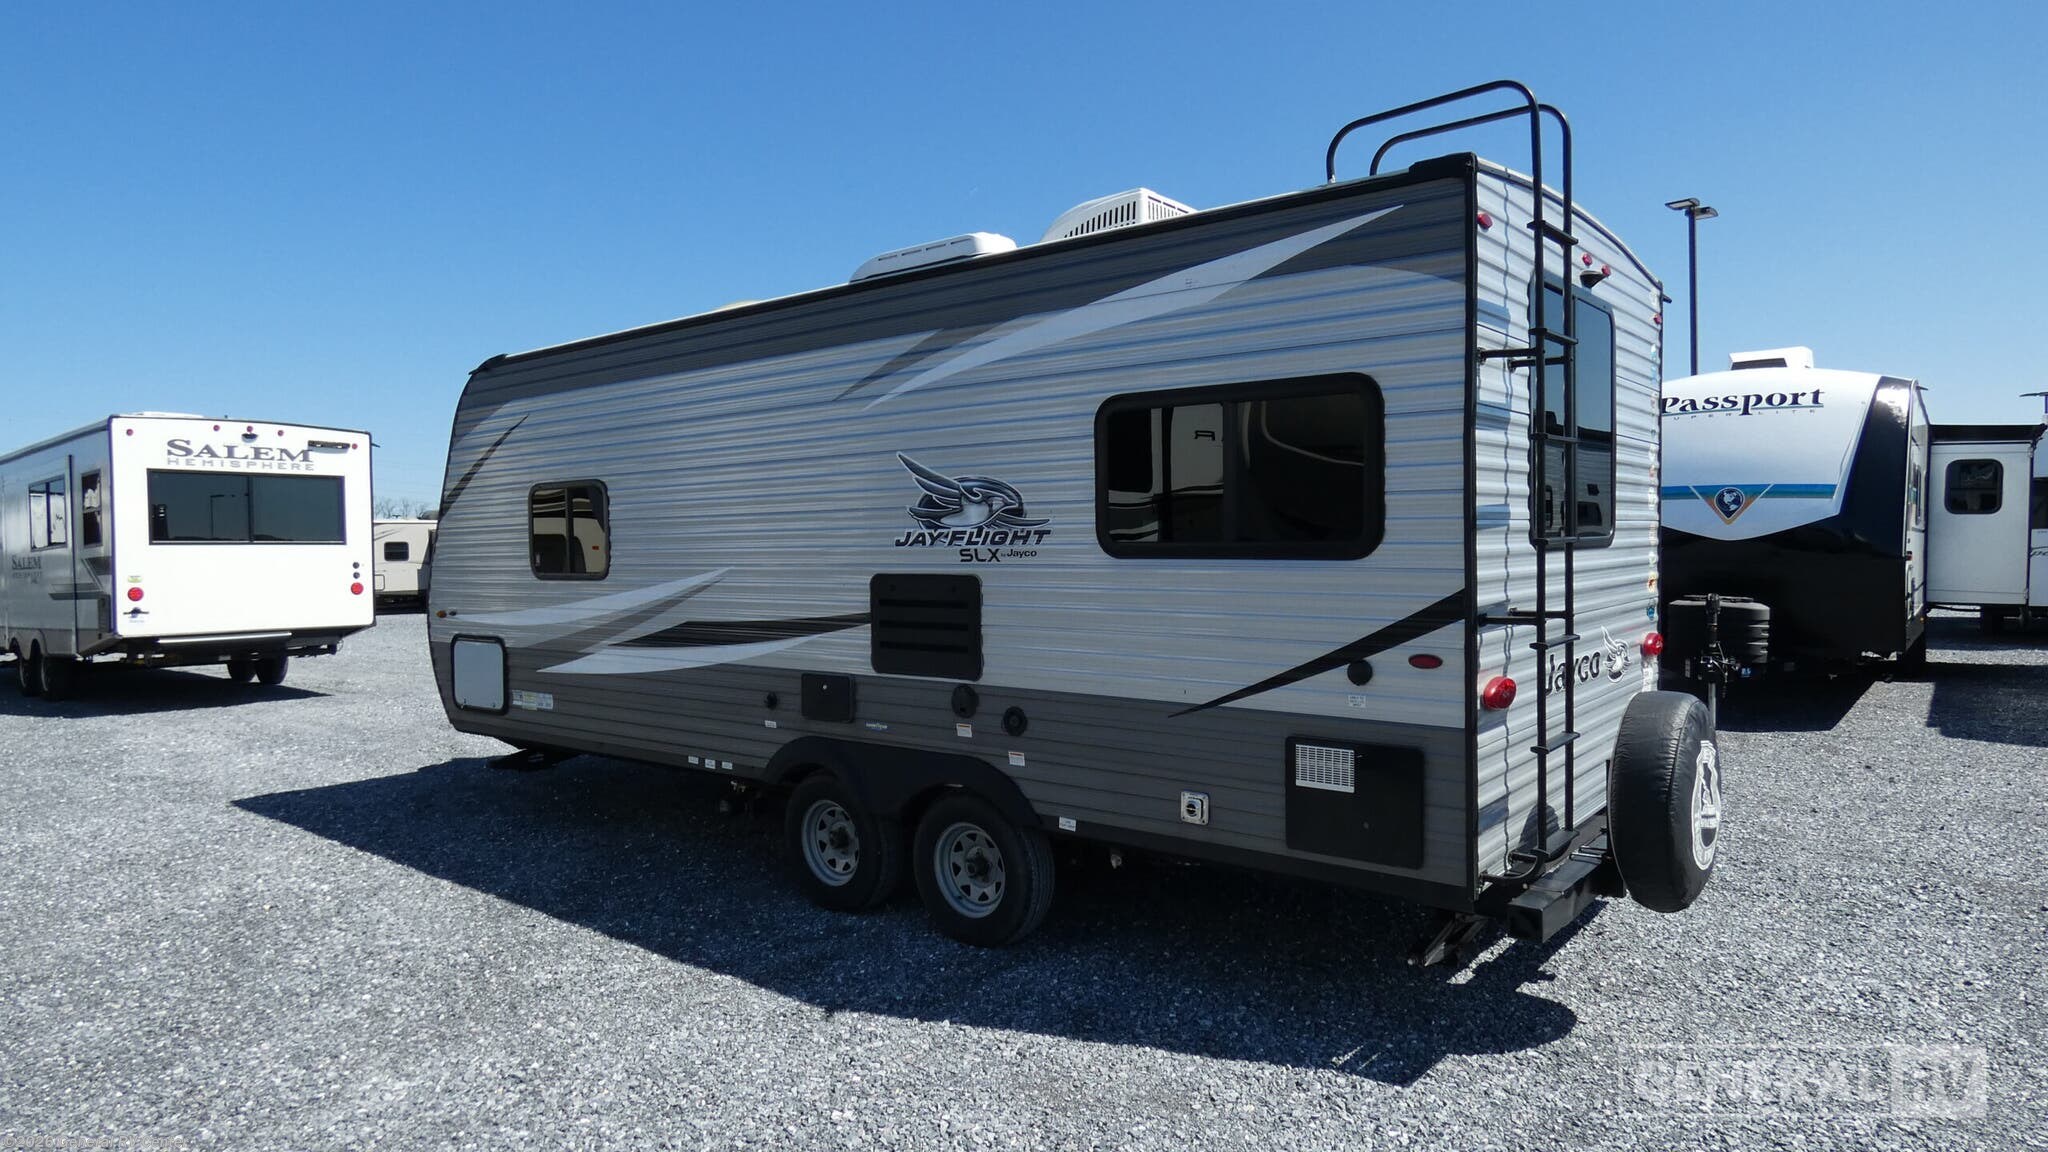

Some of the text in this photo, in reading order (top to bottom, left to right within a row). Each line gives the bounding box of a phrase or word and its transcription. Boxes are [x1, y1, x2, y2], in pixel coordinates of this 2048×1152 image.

[1661, 388, 1825, 416] Passport
[167, 438, 313, 463] SALEM
[167, 457, 315, 471] HEMISPHERE
[895, 529, 1051, 547] JAY FLIGHT
[959, 548, 1001, 562] SLX
[1007, 549, 1038, 559] Jayco
